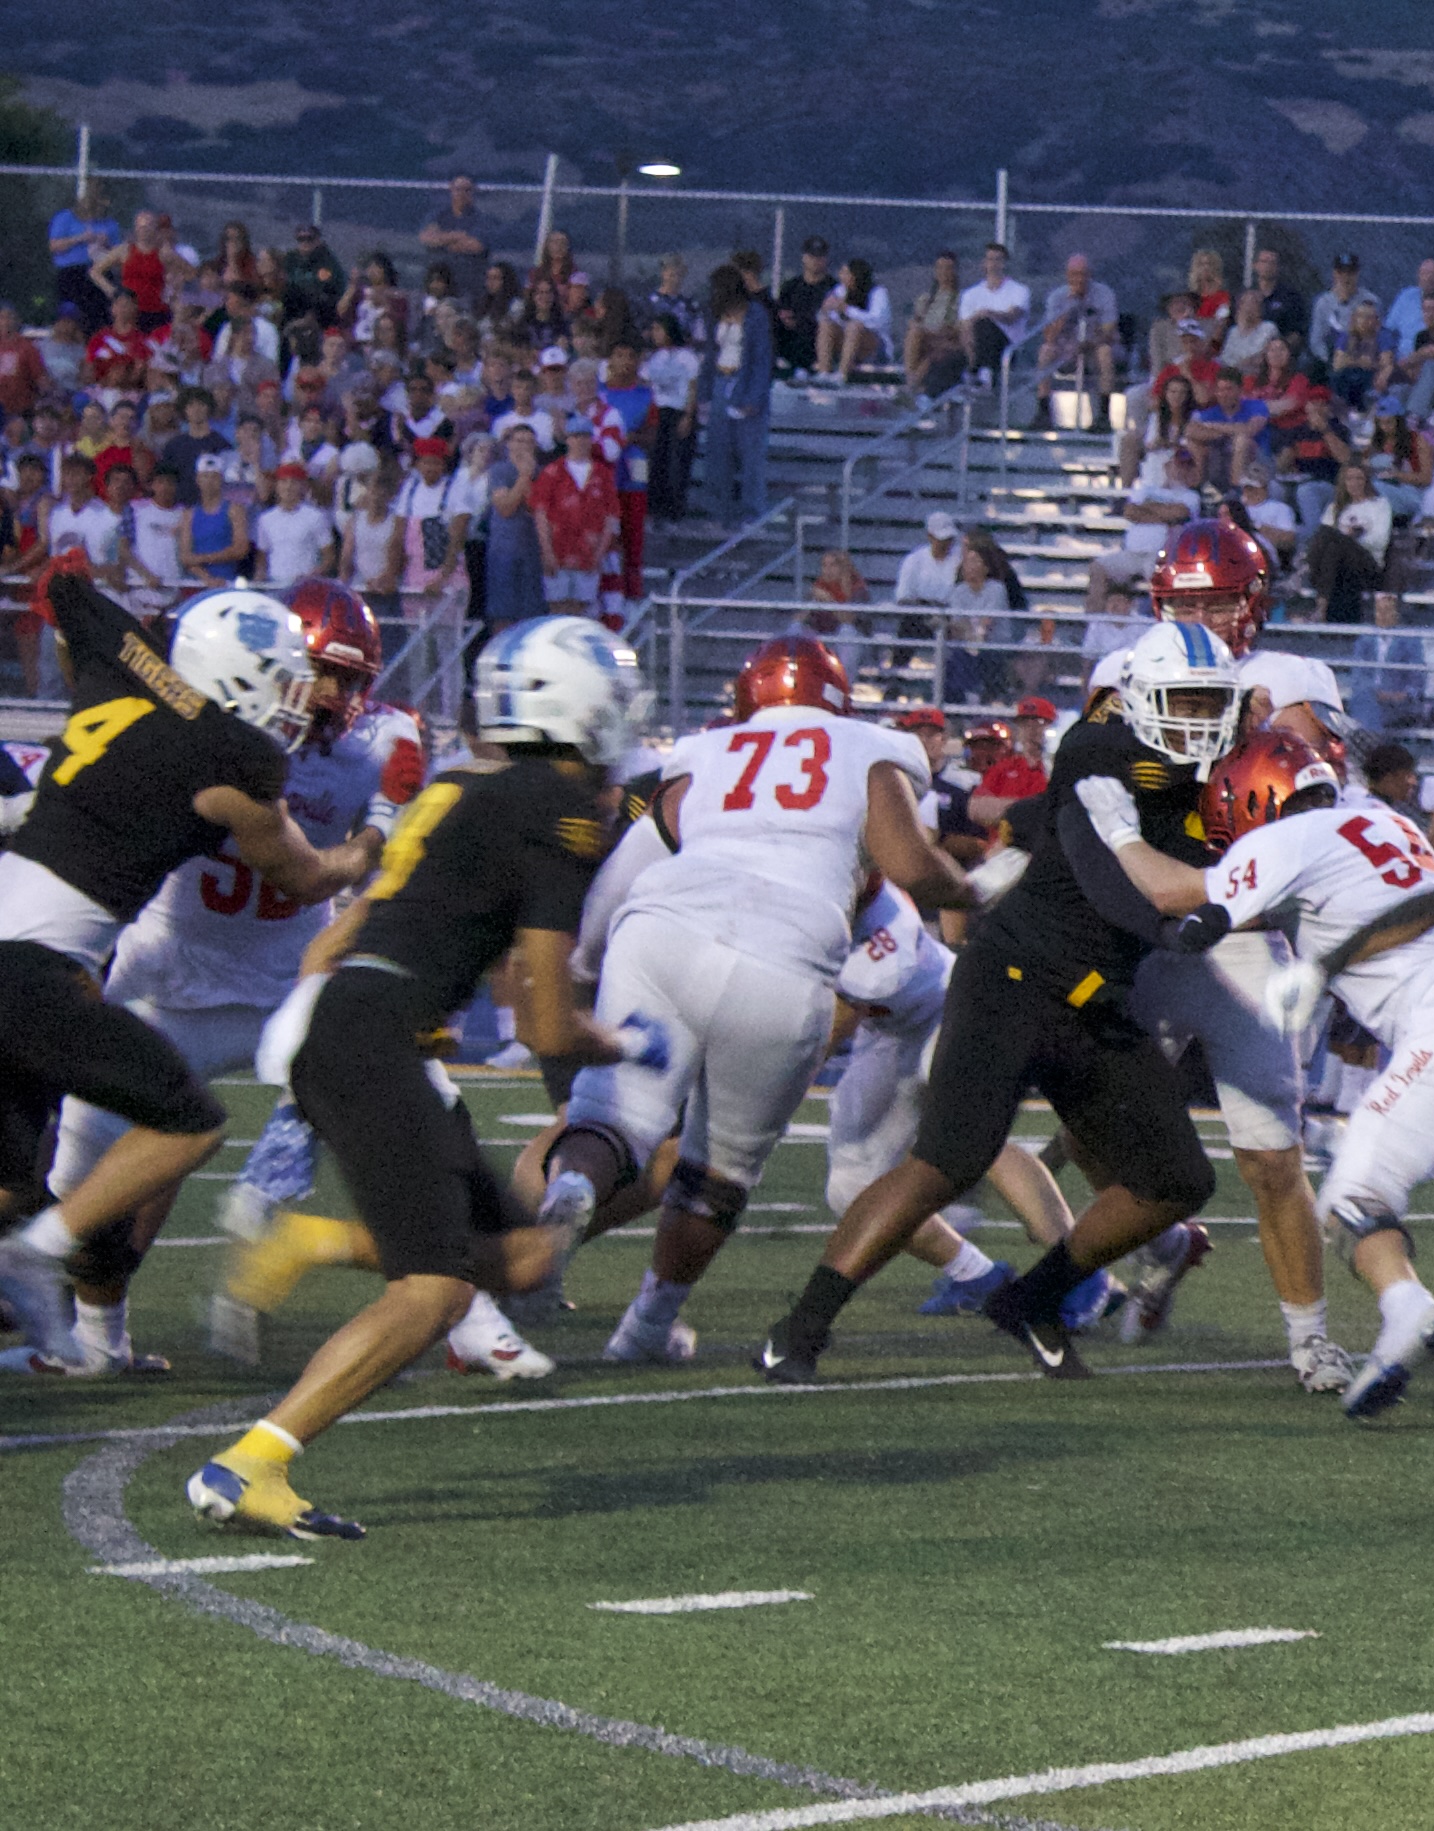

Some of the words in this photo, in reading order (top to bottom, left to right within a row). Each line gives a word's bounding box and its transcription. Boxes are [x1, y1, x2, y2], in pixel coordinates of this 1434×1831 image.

[53, 696, 157, 787] 4
[722, 728, 833, 812] 73
[1225, 859, 1258, 899] 54
[867, 927, 897, 962] 28
